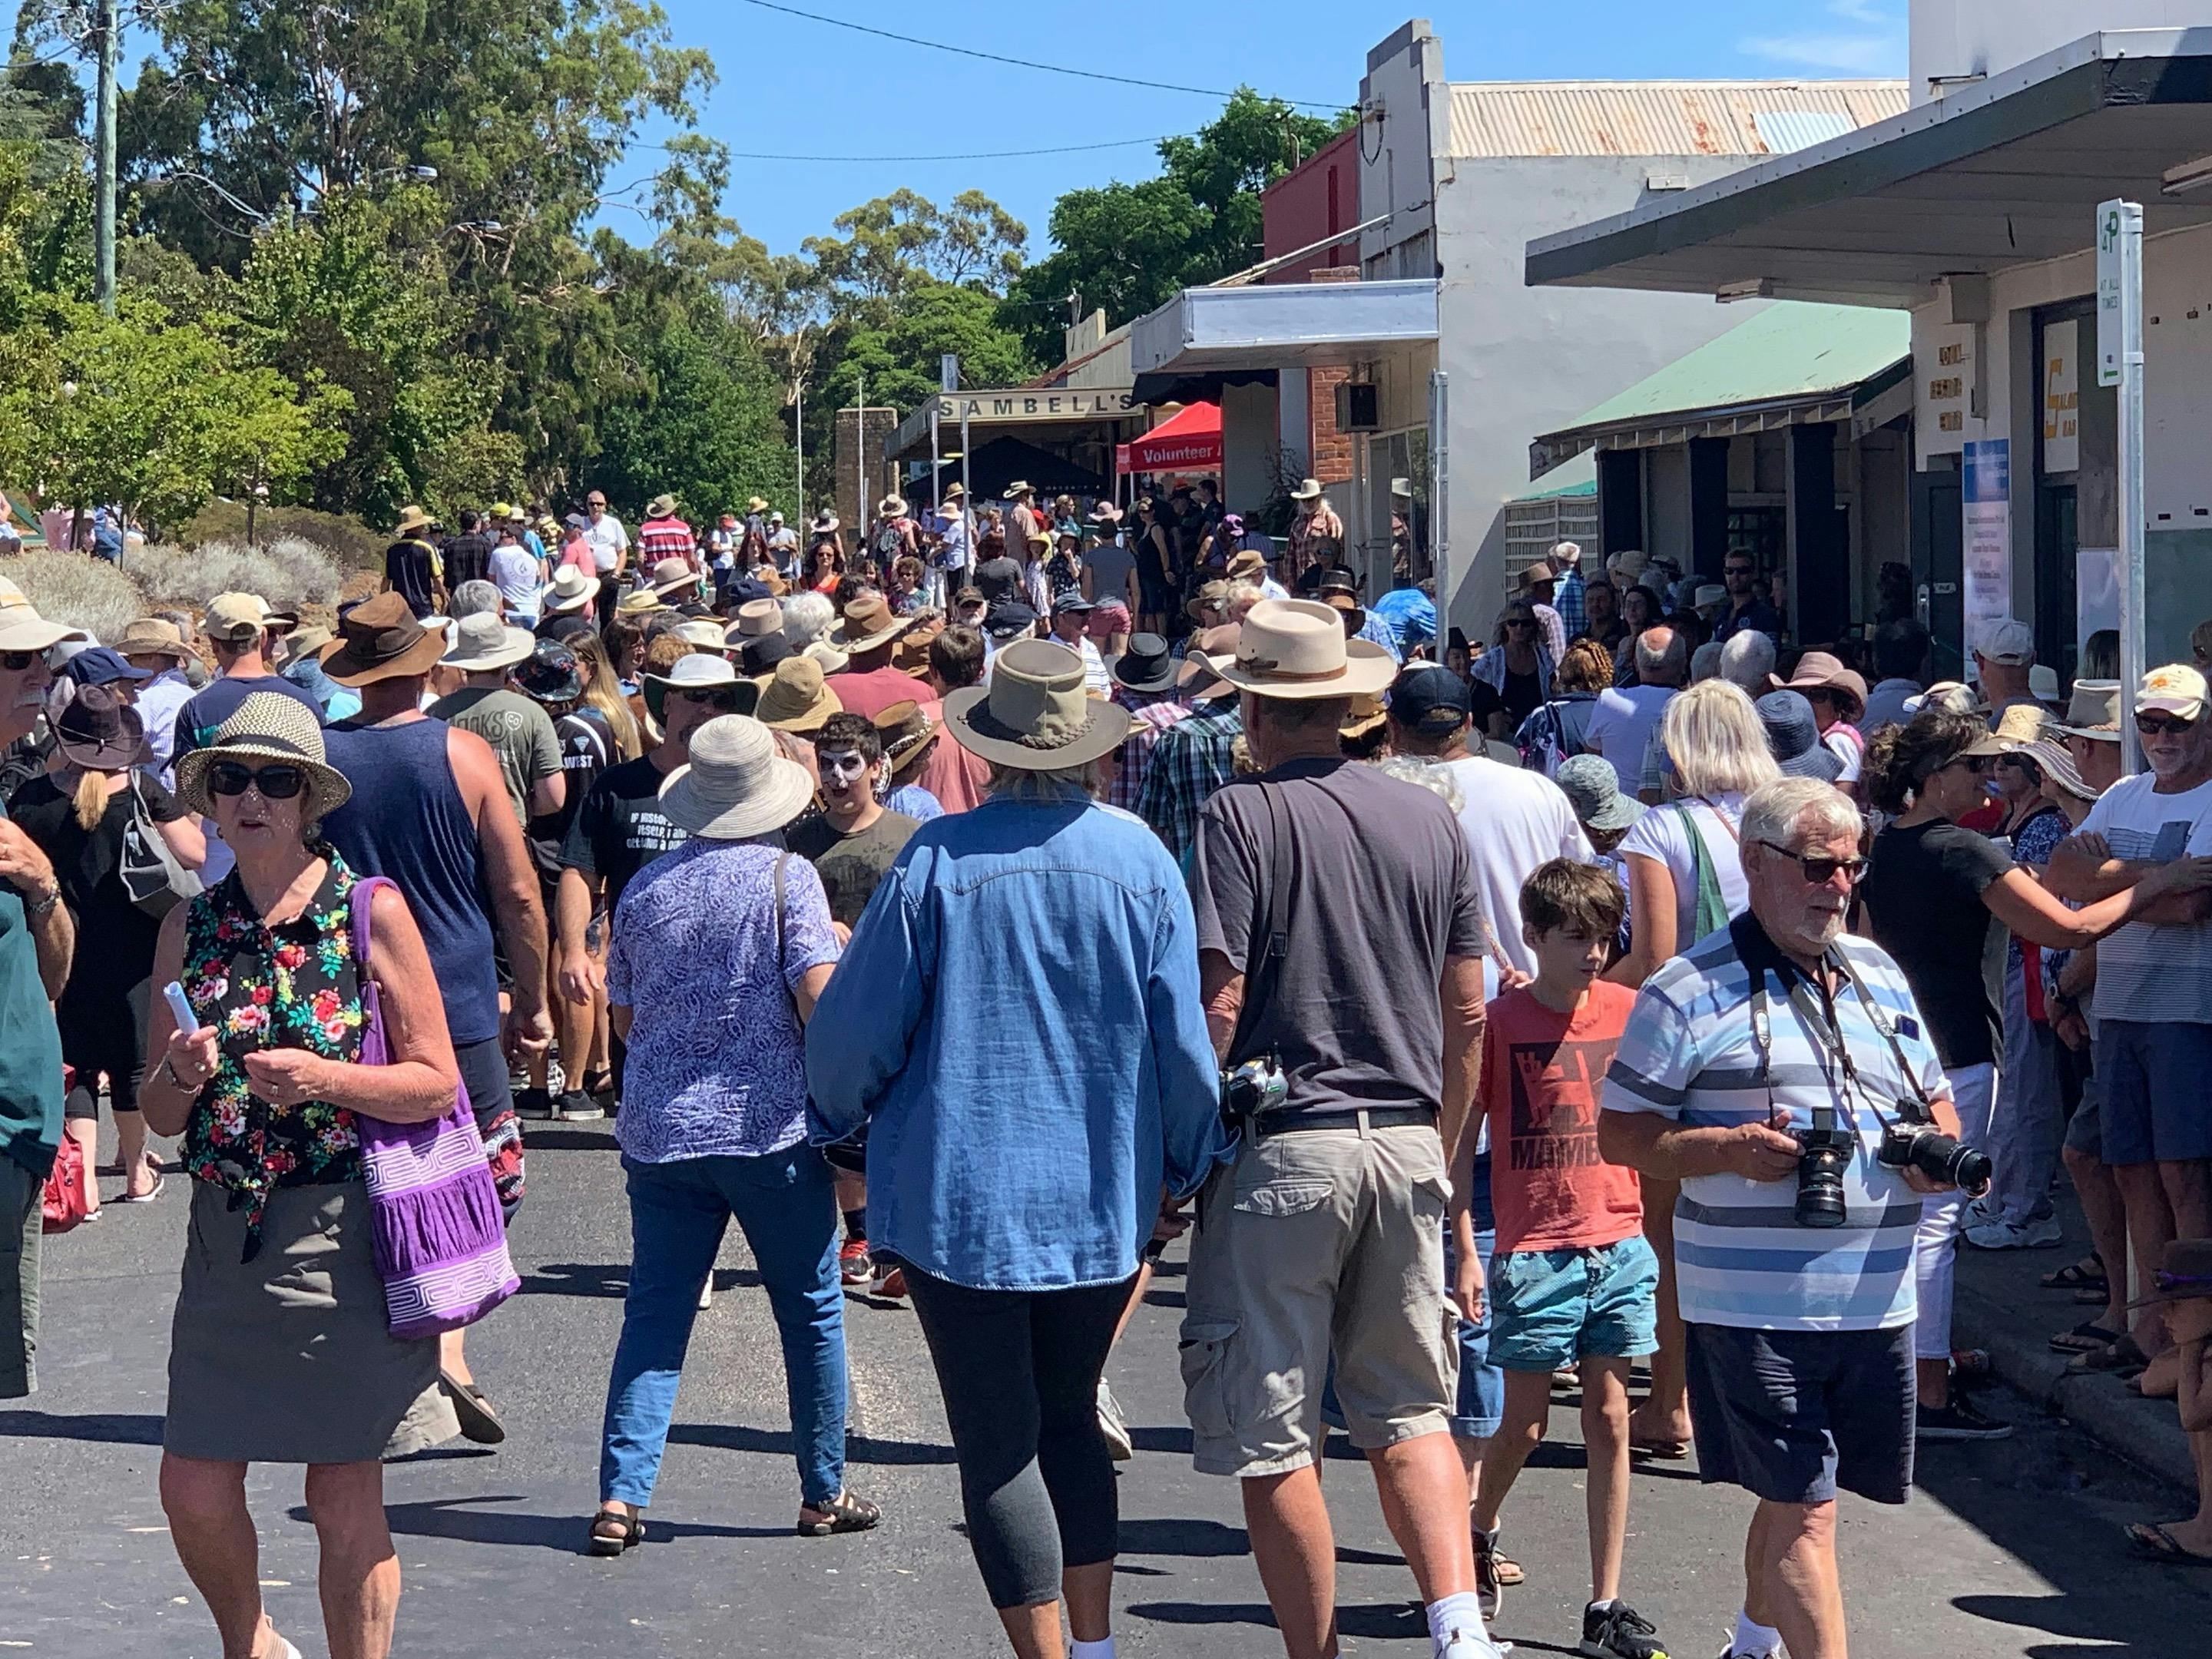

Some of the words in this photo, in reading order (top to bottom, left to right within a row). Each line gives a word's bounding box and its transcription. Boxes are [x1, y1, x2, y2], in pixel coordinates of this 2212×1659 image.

[2099, 279, 2108, 291] AT
[2109, 277, 2119, 290] ALL
[2101, 296, 2118, 309] TIMES
[940, 393, 1133, 417] SAMBELL'S
[1143, 446, 1214, 464] Volunteer
[564, 755, 594, 769] WEST
[1511, 1134, 1599, 1170] MAMB
